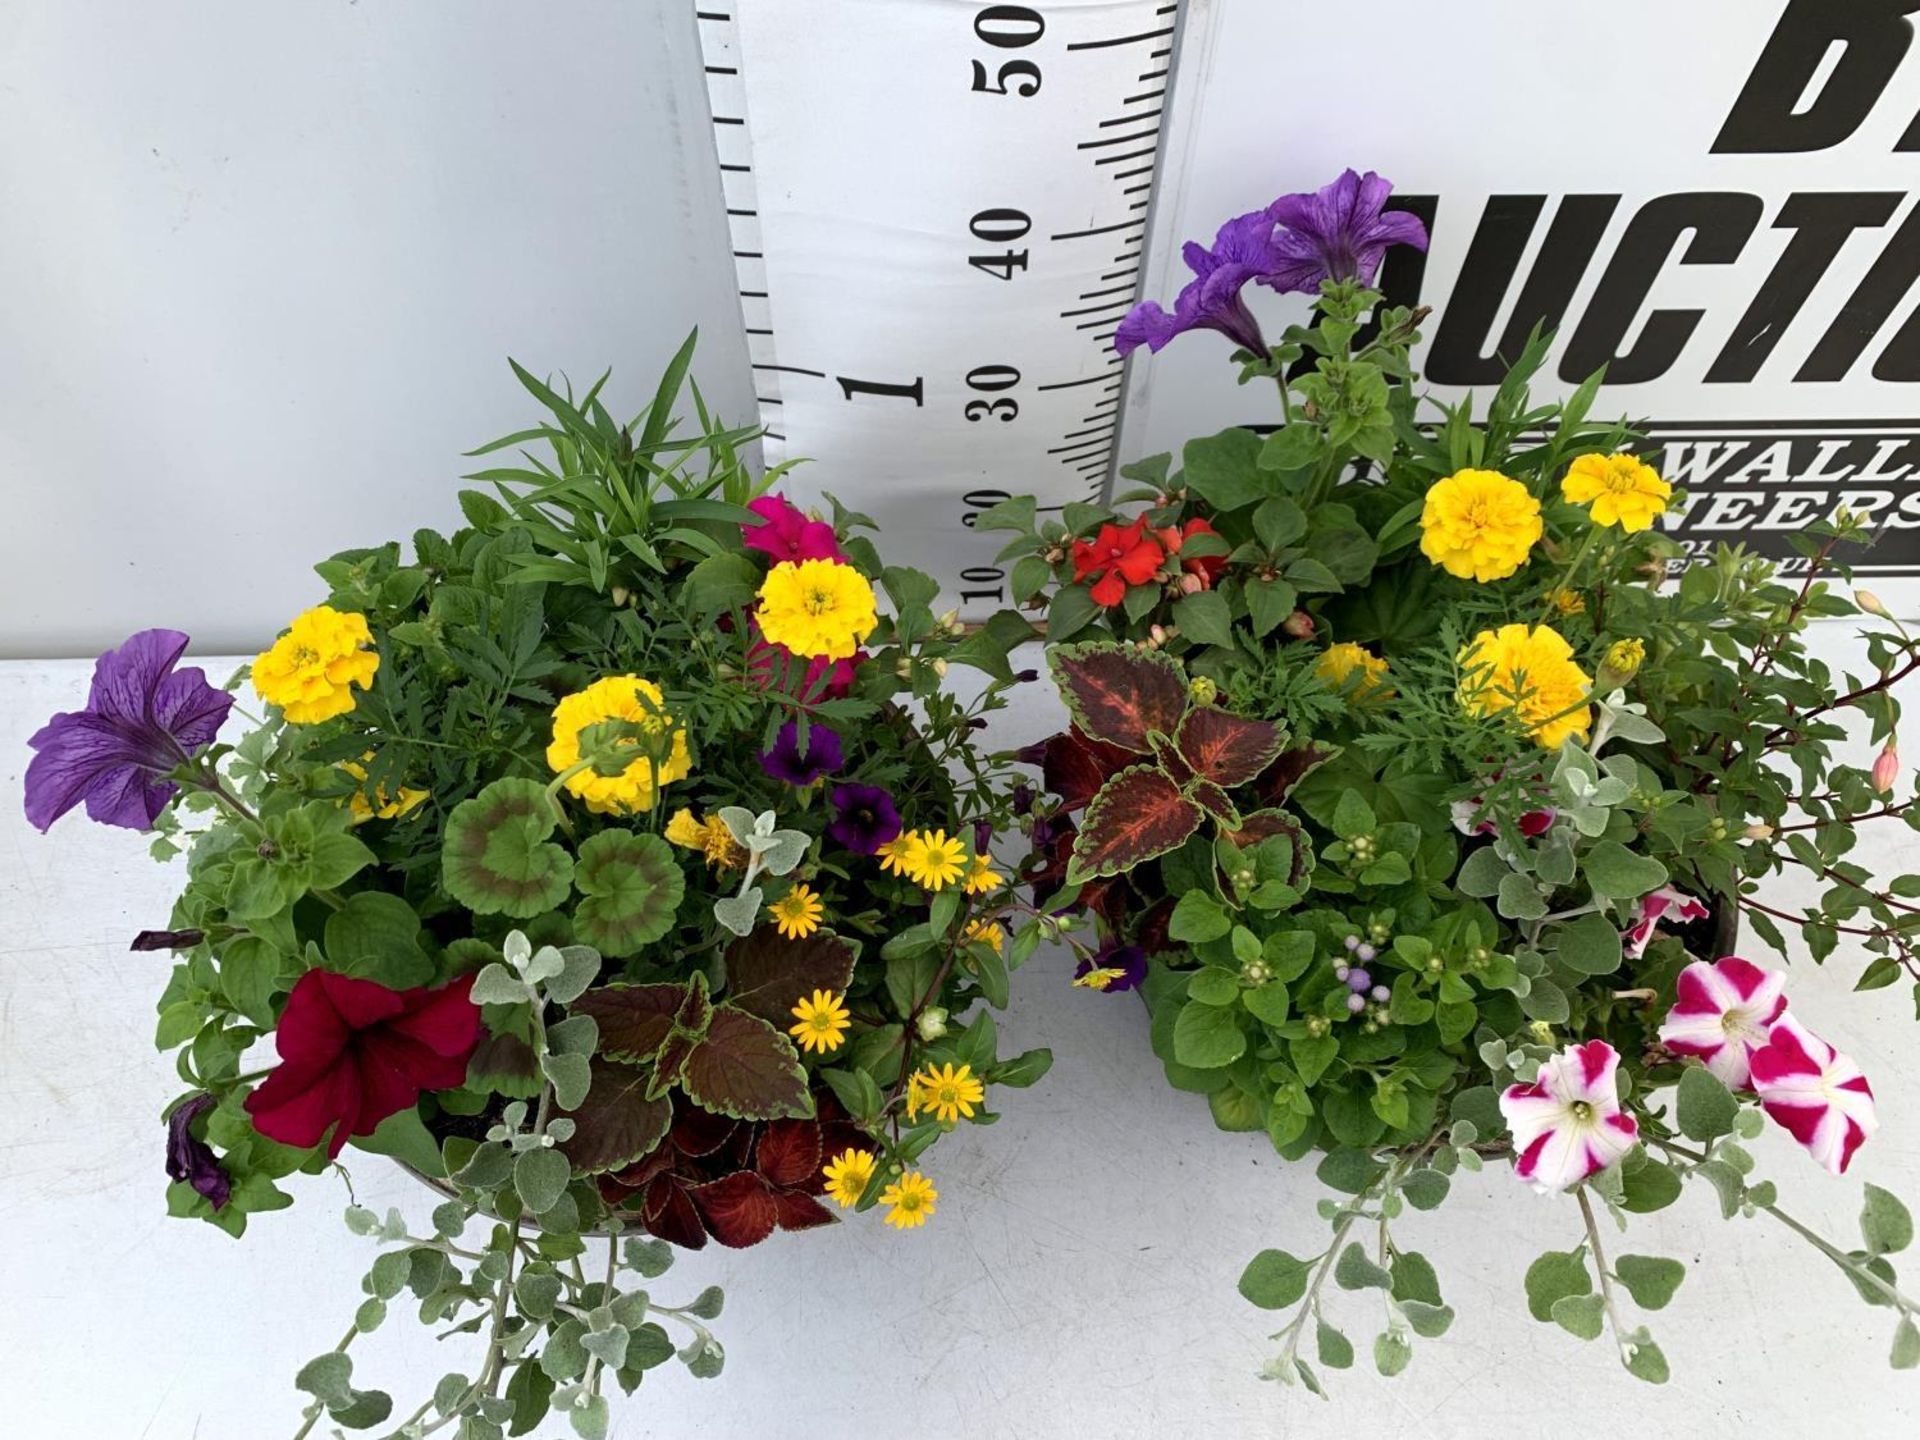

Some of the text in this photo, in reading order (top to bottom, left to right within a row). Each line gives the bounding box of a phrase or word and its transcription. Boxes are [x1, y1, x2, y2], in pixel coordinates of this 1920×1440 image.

[971, 5, 1046, 98] 50
[968, 207, 1033, 281] 40
[836, 376, 924, 407] 1
[964, 364, 1021, 423] 30
[1661, 439, 1920, 484] WALL
[960, 567, 1006, 605] 10
